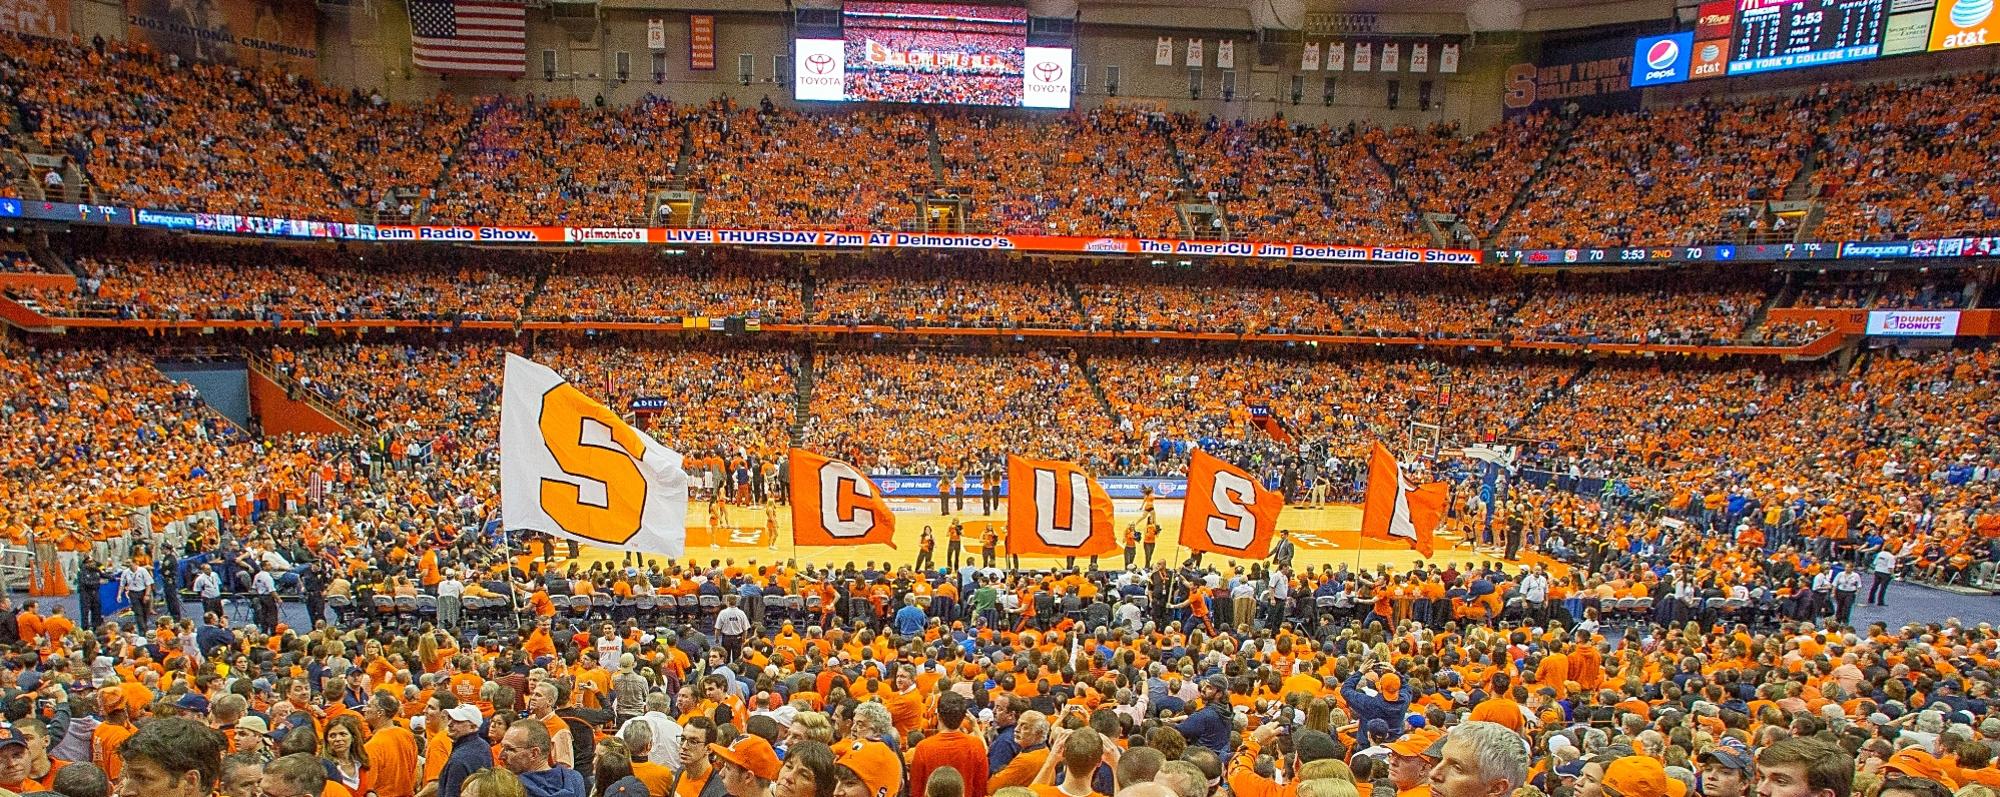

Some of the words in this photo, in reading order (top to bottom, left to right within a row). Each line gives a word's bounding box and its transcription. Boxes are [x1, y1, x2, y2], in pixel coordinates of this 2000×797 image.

[1791, 2, 1803, 11] 70
[1791, 11, 1823, 26] 3:53
[170, 23, 236, 44] NATIONAL
[242, 37, 317, 58] CHAMPIONS
[1943, 28, 1989, 48] at&t
[1731, 61, 1753, 71] NEW
[1756, 56, 1794, 69] YORK'S
[1796, 49, 1844, 65] COLLEGE
[1847, 44, 1879, 58] TEAM
[1538, 64, 1572, 83] NEW
[1645, 68, 1676, 80] pepsi
[1695, 62, 1720, 75] at&t
[800, 77, 841, 86] TOYOTA
[1028, 84, 1067, 93] TOYOTA
[1505, 63, 1536, 108] S
[1538, 80, 1597, 99] COLLEGE
[78, 204, 91, 213] FL
[99, 205, 117, 215] TOL
[138, 210, 194, 228] foursquare
[420, 227, 474, 240] Radio
[479, 228, 537, 240] Show.
[571, 228, 641, 241] Delmonico's
[667, 230, 711, 241] LIVE!
[718, 231, 818, 243] THURSDAY
[824, 232, 863, 246] 7pm
[868, 233, 891, 245] AT
[897, 234, 1014, 248] Delmonico's.
[1140, 240, 1171, 252] The
[1176, 242, 1252, 255] AmeriCU
[1257, 244, 1286, 256] Jim
[1293, 246, 1366, 259] Boeheim
[1372, 248, 1420, 260] Radio
[1425, 250, 1475, 263] Show.
[1496, 250, 1509, 258] TOL
[1589, 250, 1604, 260] 70
[1621, 250, 1645, 260] 3:53
[1651, 250, 1672, 259] 2ND
[1686, 248, 1703, 259] 70
[1784, 243, 1796, 251] FL
[1803, 243, 1822, 251] TOL
[1843, 243, 1909, 258] foursquare
[1849, 313, 1864, 323] 112
[1900, 315, 1945, 323] DUNKIN'
[538, 381, 648, 546] S
[818, 460, 875, 539] C
[1034, 468, 1093, 549] U
[1206, 470, 1257, 551] S
